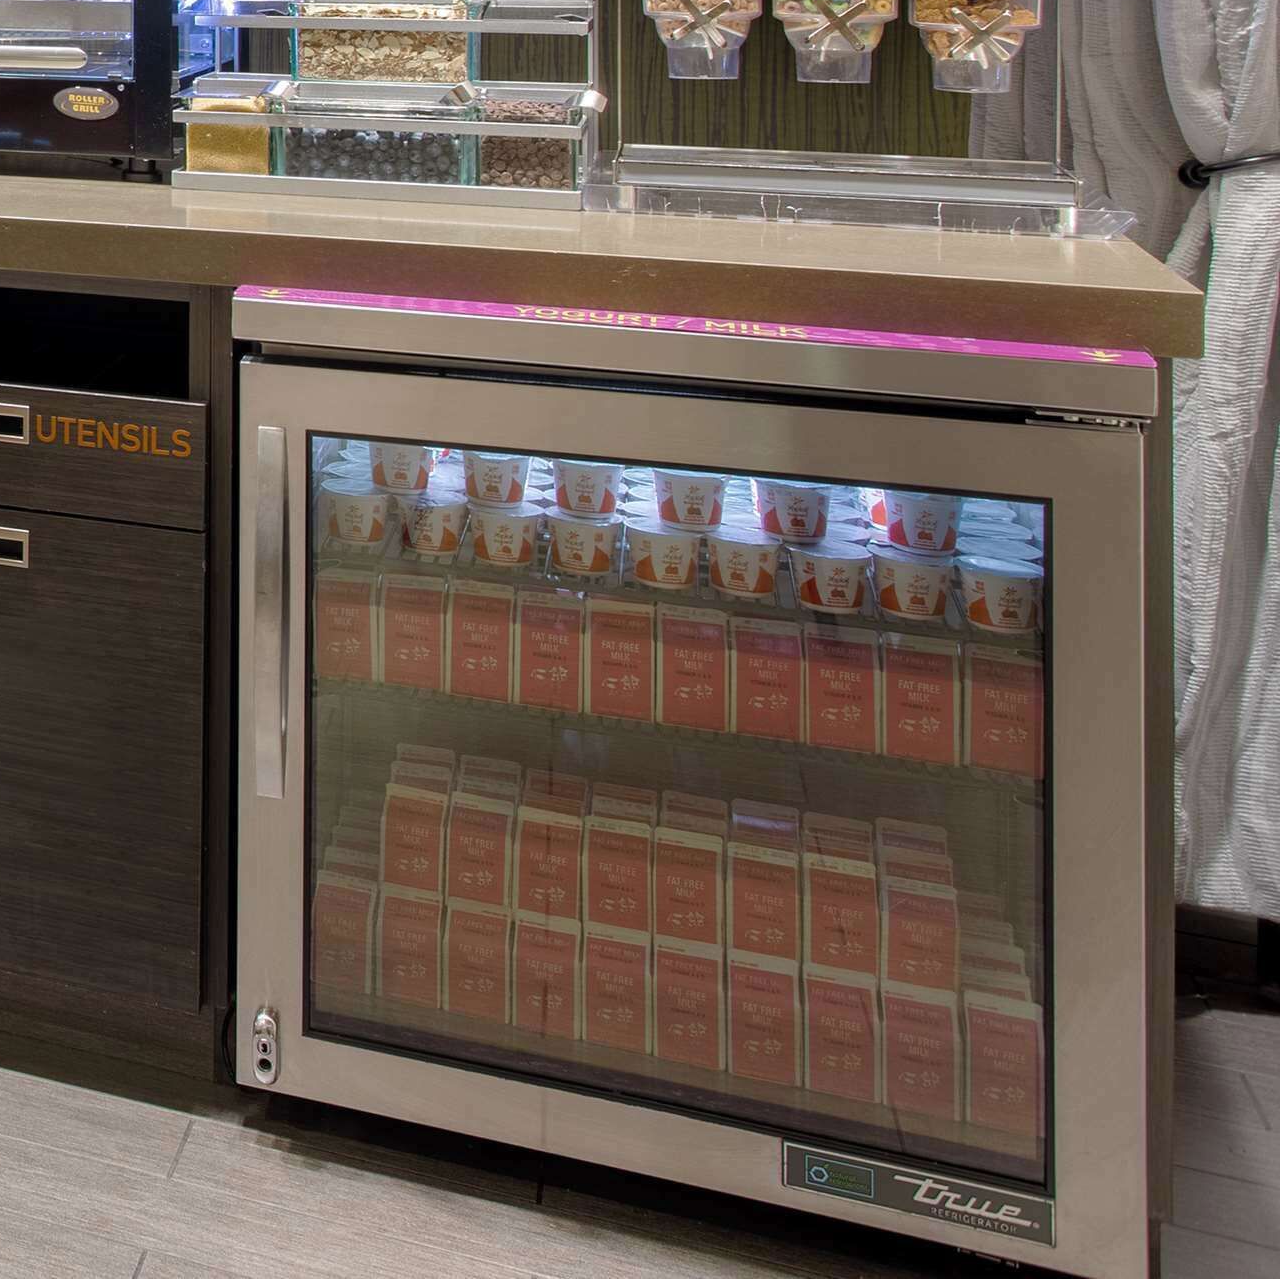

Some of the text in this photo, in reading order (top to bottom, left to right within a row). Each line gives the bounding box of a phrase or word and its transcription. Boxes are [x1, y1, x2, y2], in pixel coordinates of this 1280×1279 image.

[68, 94, 105, 104] ROLLER
[73, 104, 100, 113] GRILL
[514, 305, 664, 328] YOGURT
[704, 319, 809, 339] MILK
[36, 413, 192, 458] UTENSILS
[898, 680, 940, 694] FAT FREE
[930, 1206, 1018, 1233] REFRIGERATOR
